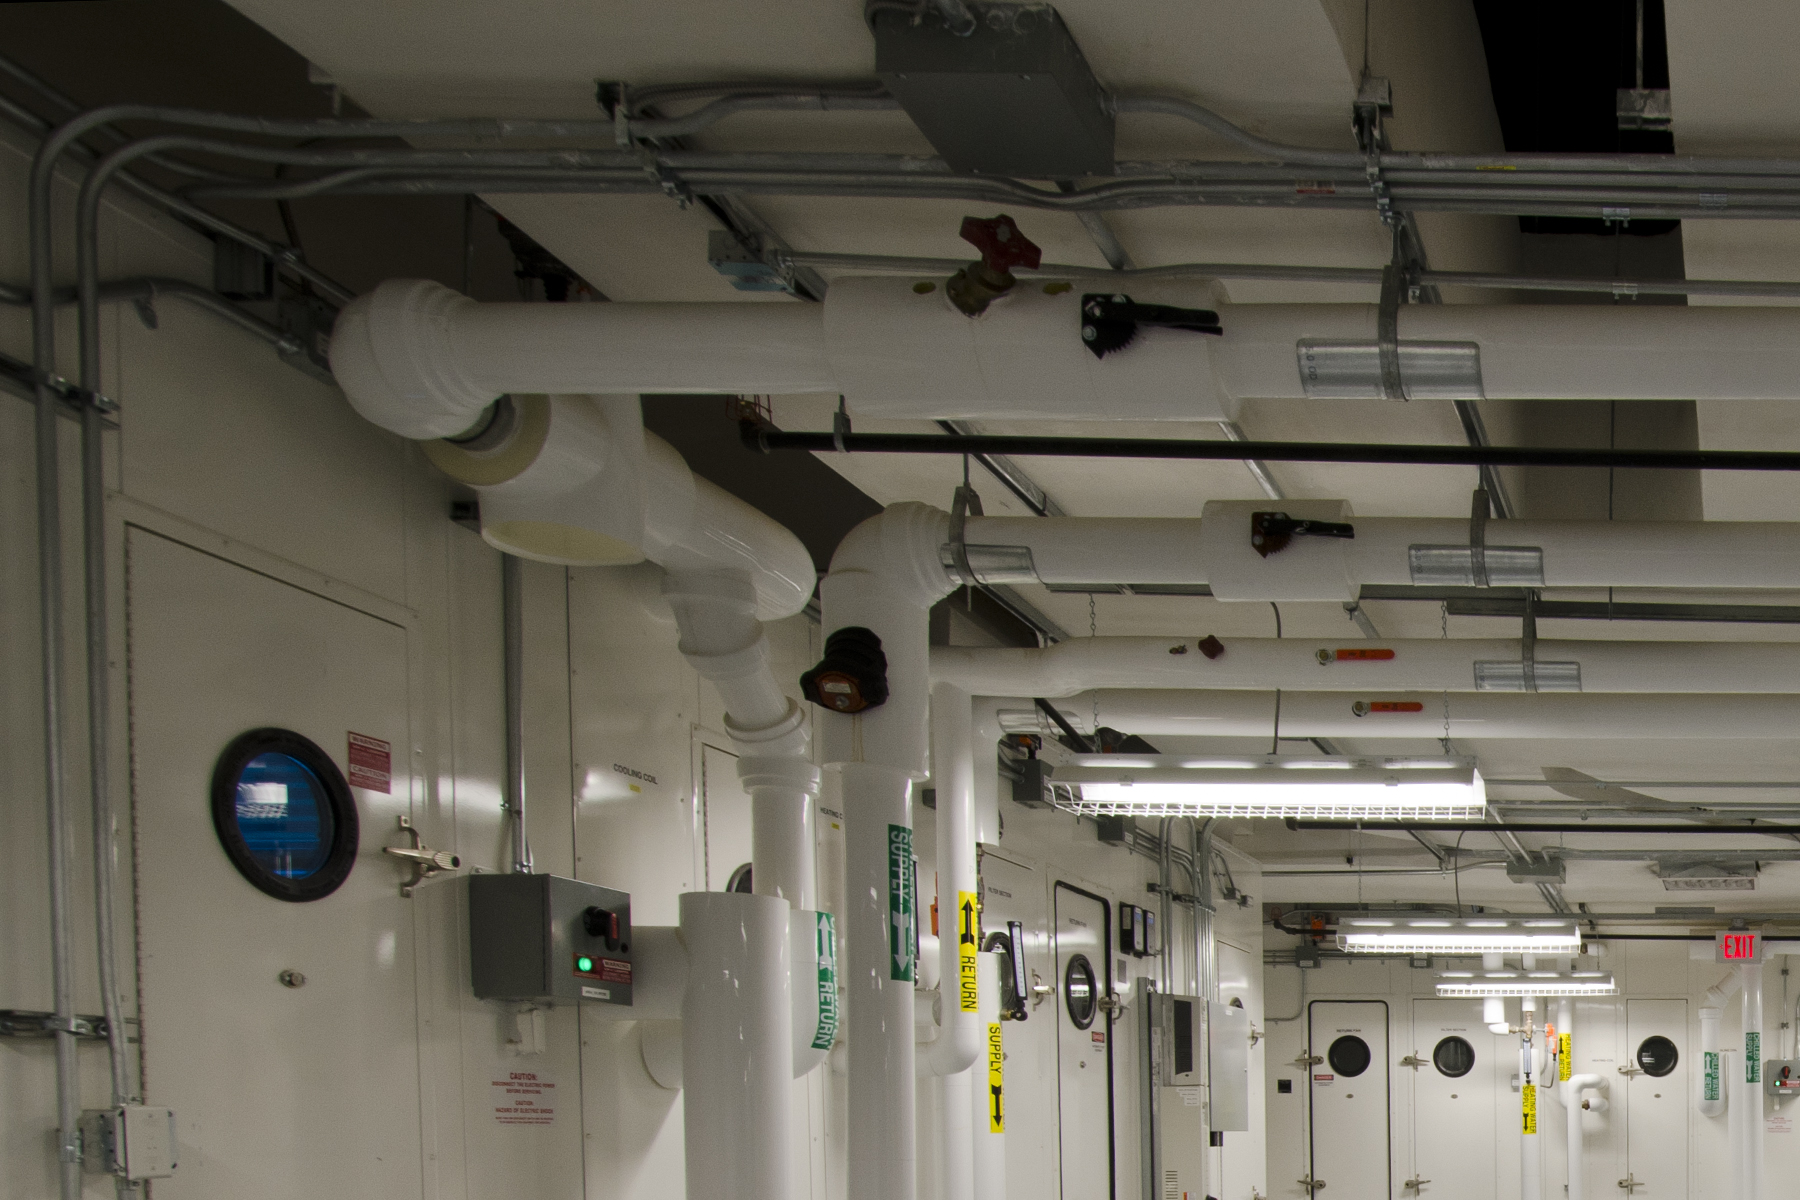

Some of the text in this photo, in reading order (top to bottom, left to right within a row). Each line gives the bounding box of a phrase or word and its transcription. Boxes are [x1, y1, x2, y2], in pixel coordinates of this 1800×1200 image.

[614, 764, 642, 779] COOLING
[890, 830, 910, 901] SUPPLY
[1724, 934, 1755, 959] EXIT
[962, 956, 977, 1010] RETURN
[814, 981, 835, 1046] RETURN
[990, 1026, 1001, 1073] SUPPLY
